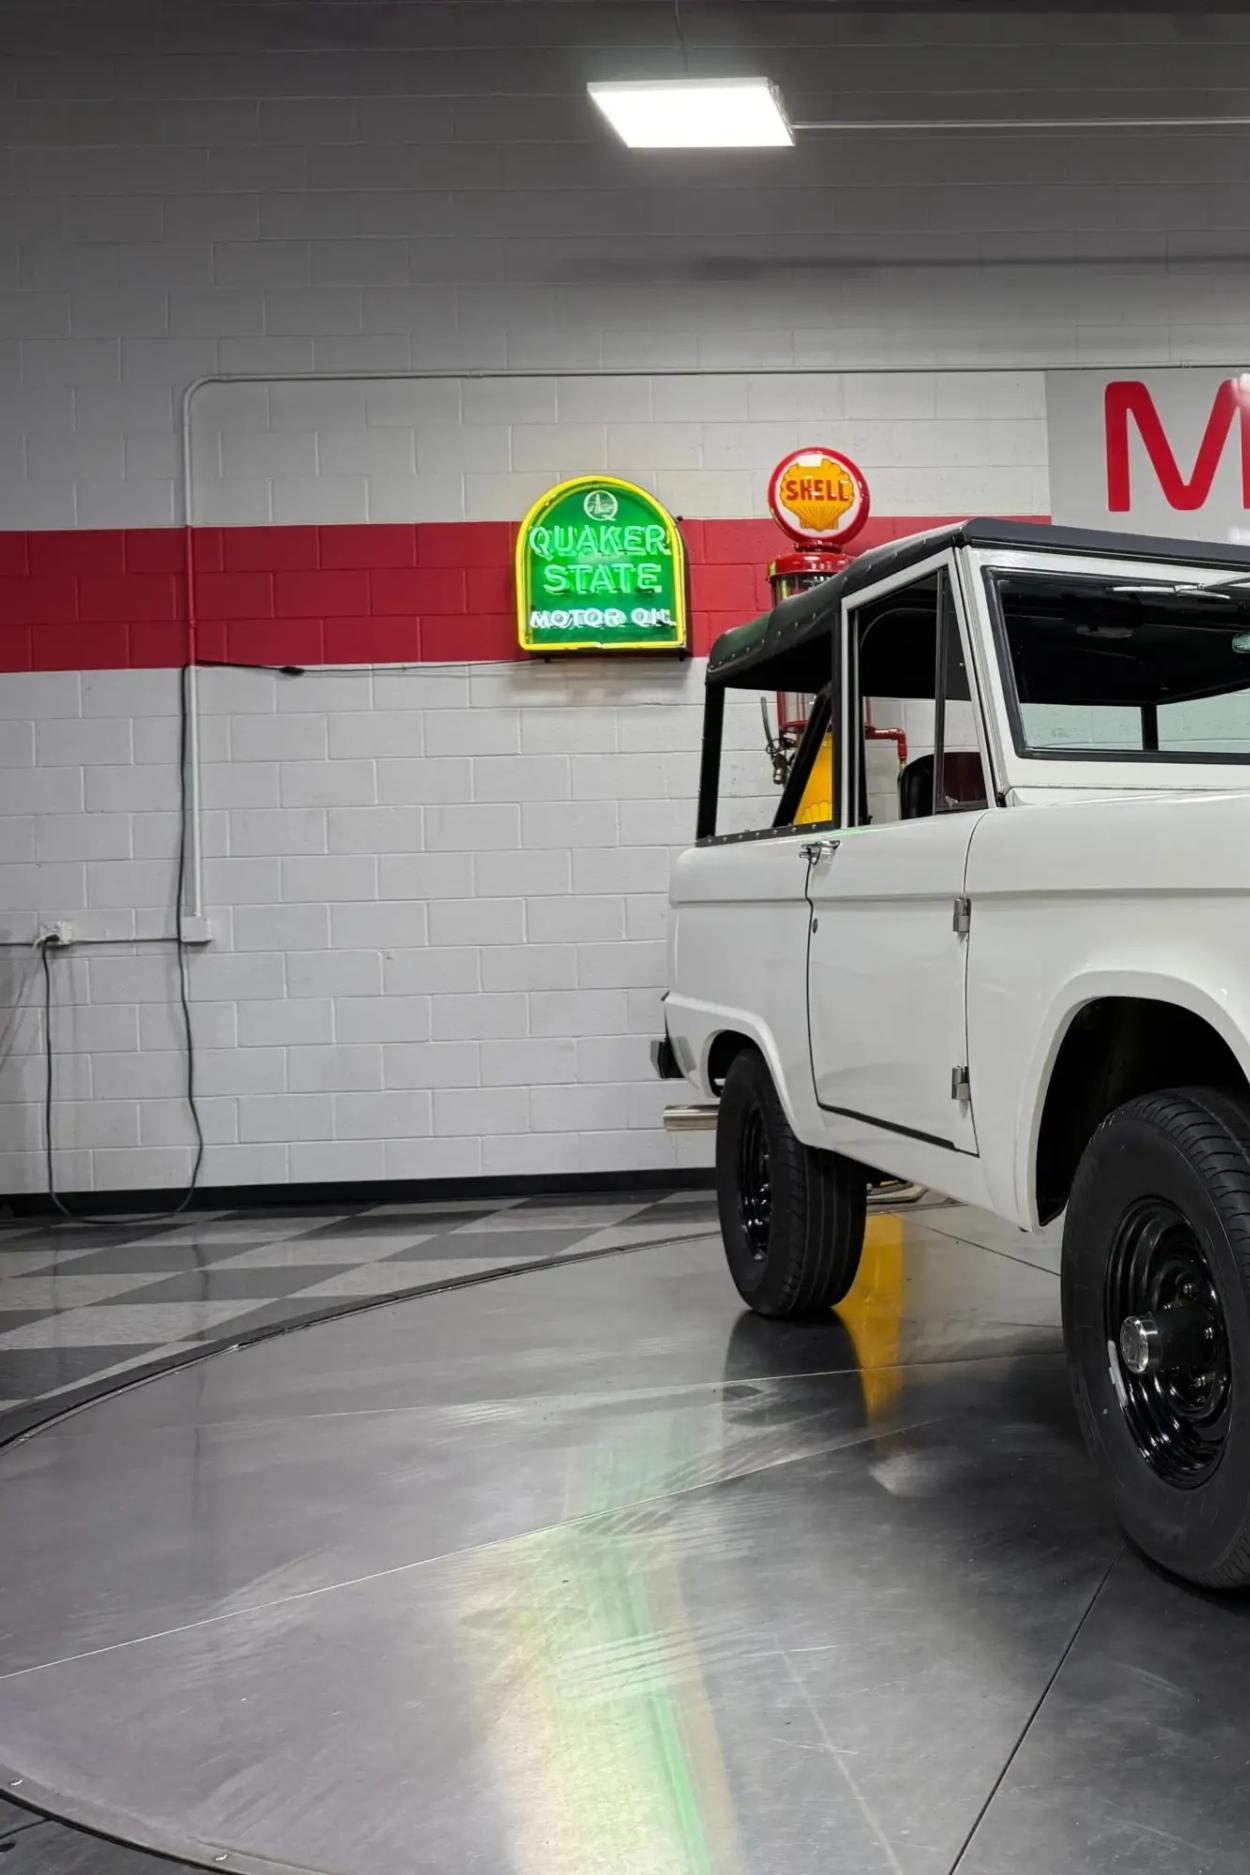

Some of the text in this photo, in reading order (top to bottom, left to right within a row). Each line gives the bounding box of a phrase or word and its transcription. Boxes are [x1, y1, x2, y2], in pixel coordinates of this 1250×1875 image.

[785, 478, 850, 503] SHELL
[529, 525, 671, 561] QUAKER
[543, 563, 662, 594] STATE
[530, 608, 677, 630] MOTOR OIL
